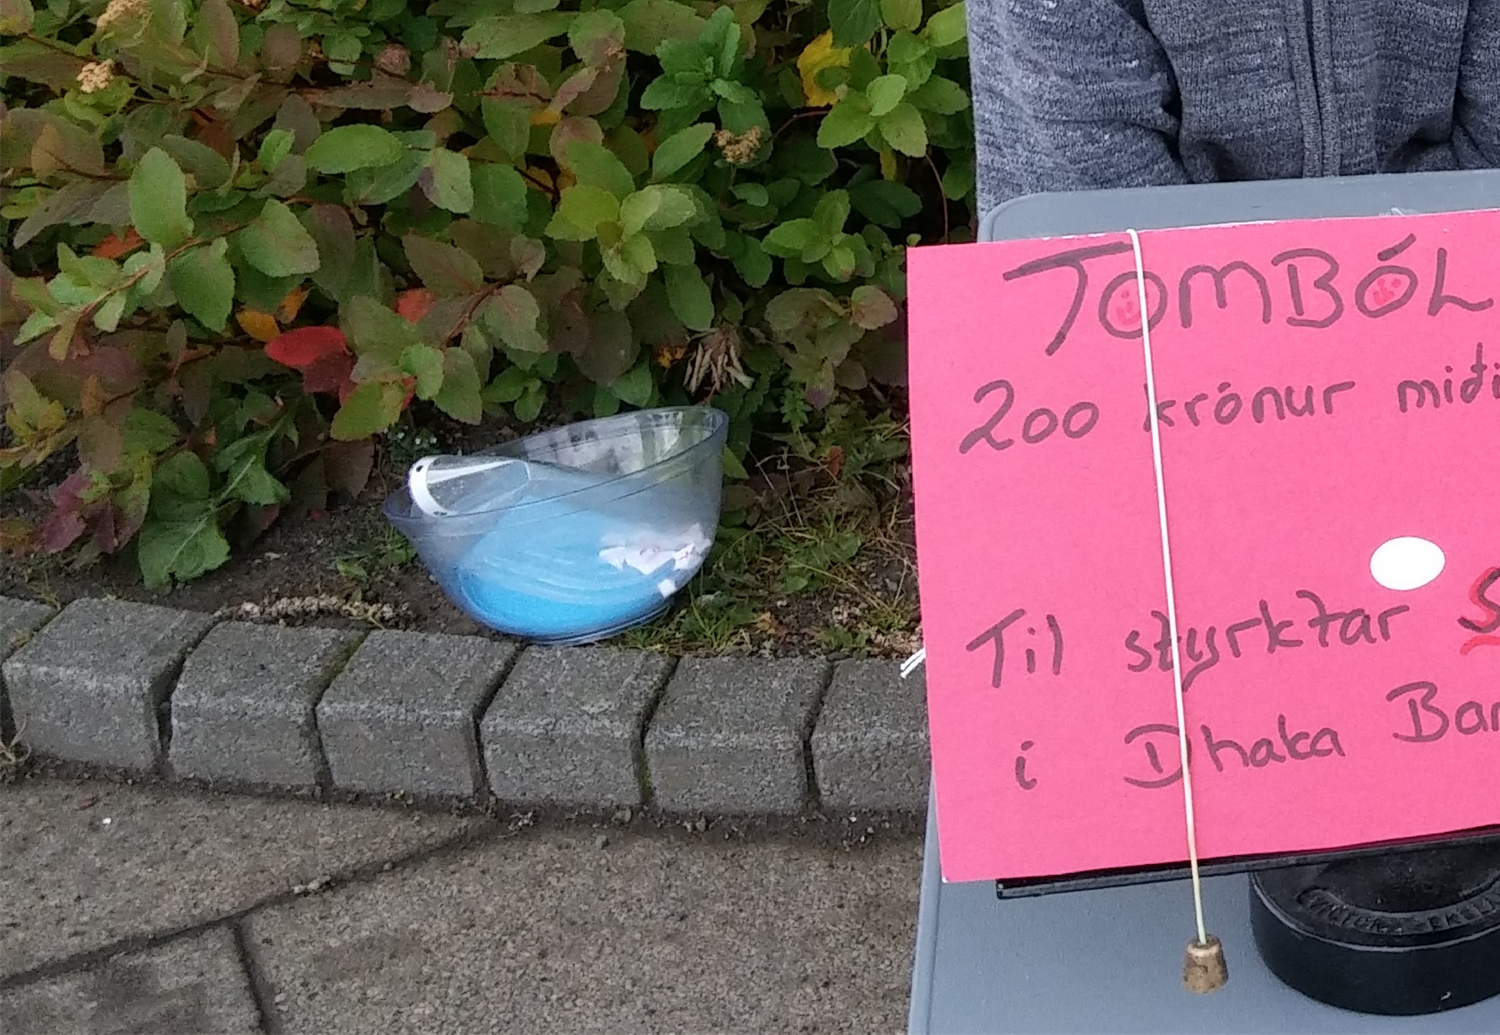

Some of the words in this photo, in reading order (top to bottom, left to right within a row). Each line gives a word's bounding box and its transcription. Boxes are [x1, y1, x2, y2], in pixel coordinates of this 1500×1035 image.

[959, 380, 1099, 454] 200
[1144, 381, 1355, 433] krónur
[966, 609, 1063, 688] Til
[1123, 714, 1345, 789] Dhaka
